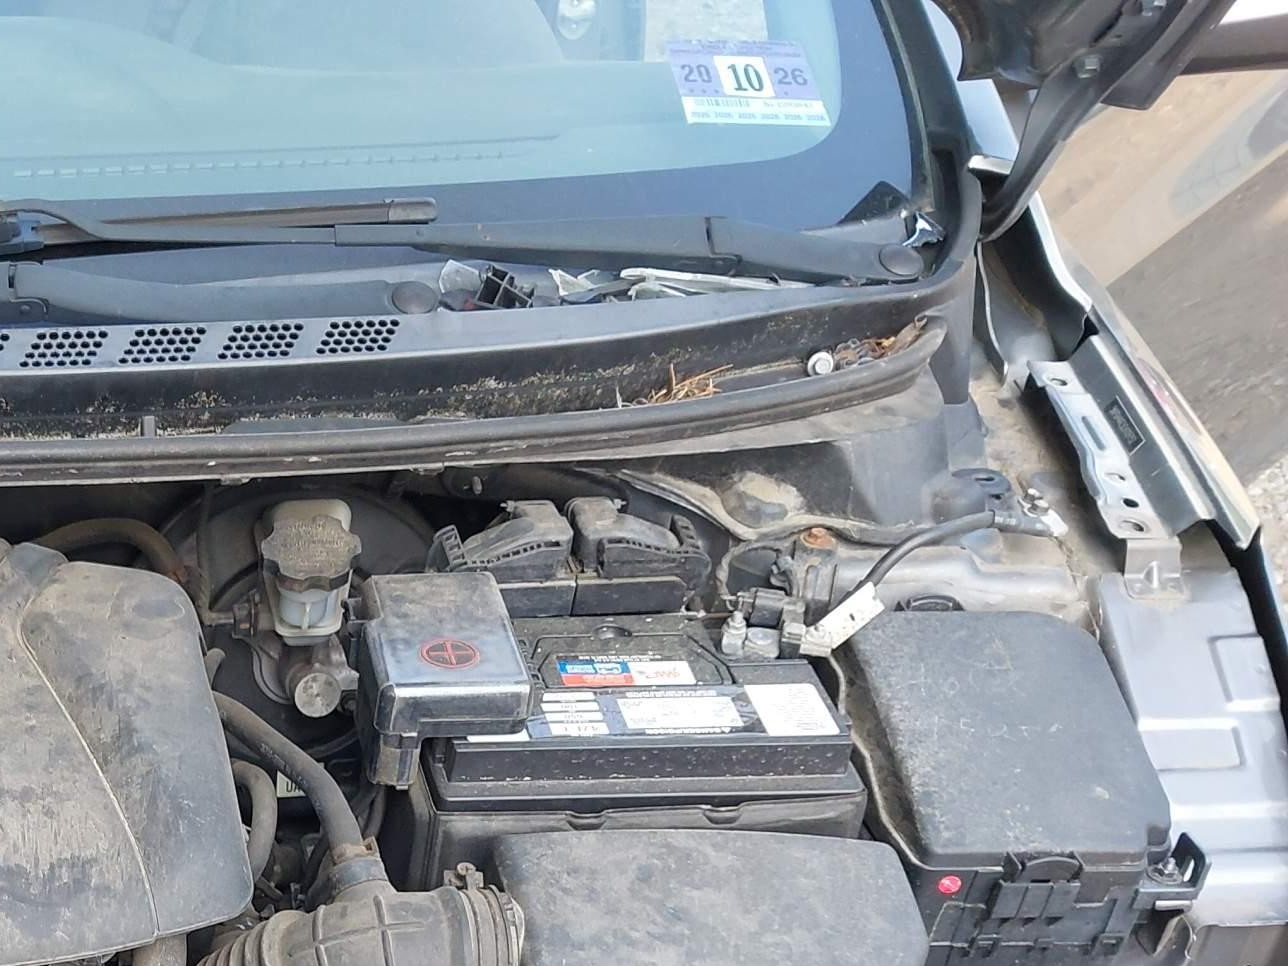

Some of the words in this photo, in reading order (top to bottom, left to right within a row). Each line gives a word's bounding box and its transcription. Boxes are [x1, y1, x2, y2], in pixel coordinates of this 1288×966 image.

[681, 64, 712, 83] 20
[728, 64, 764, 92] 10
[774, 67, 808, 86] 26
